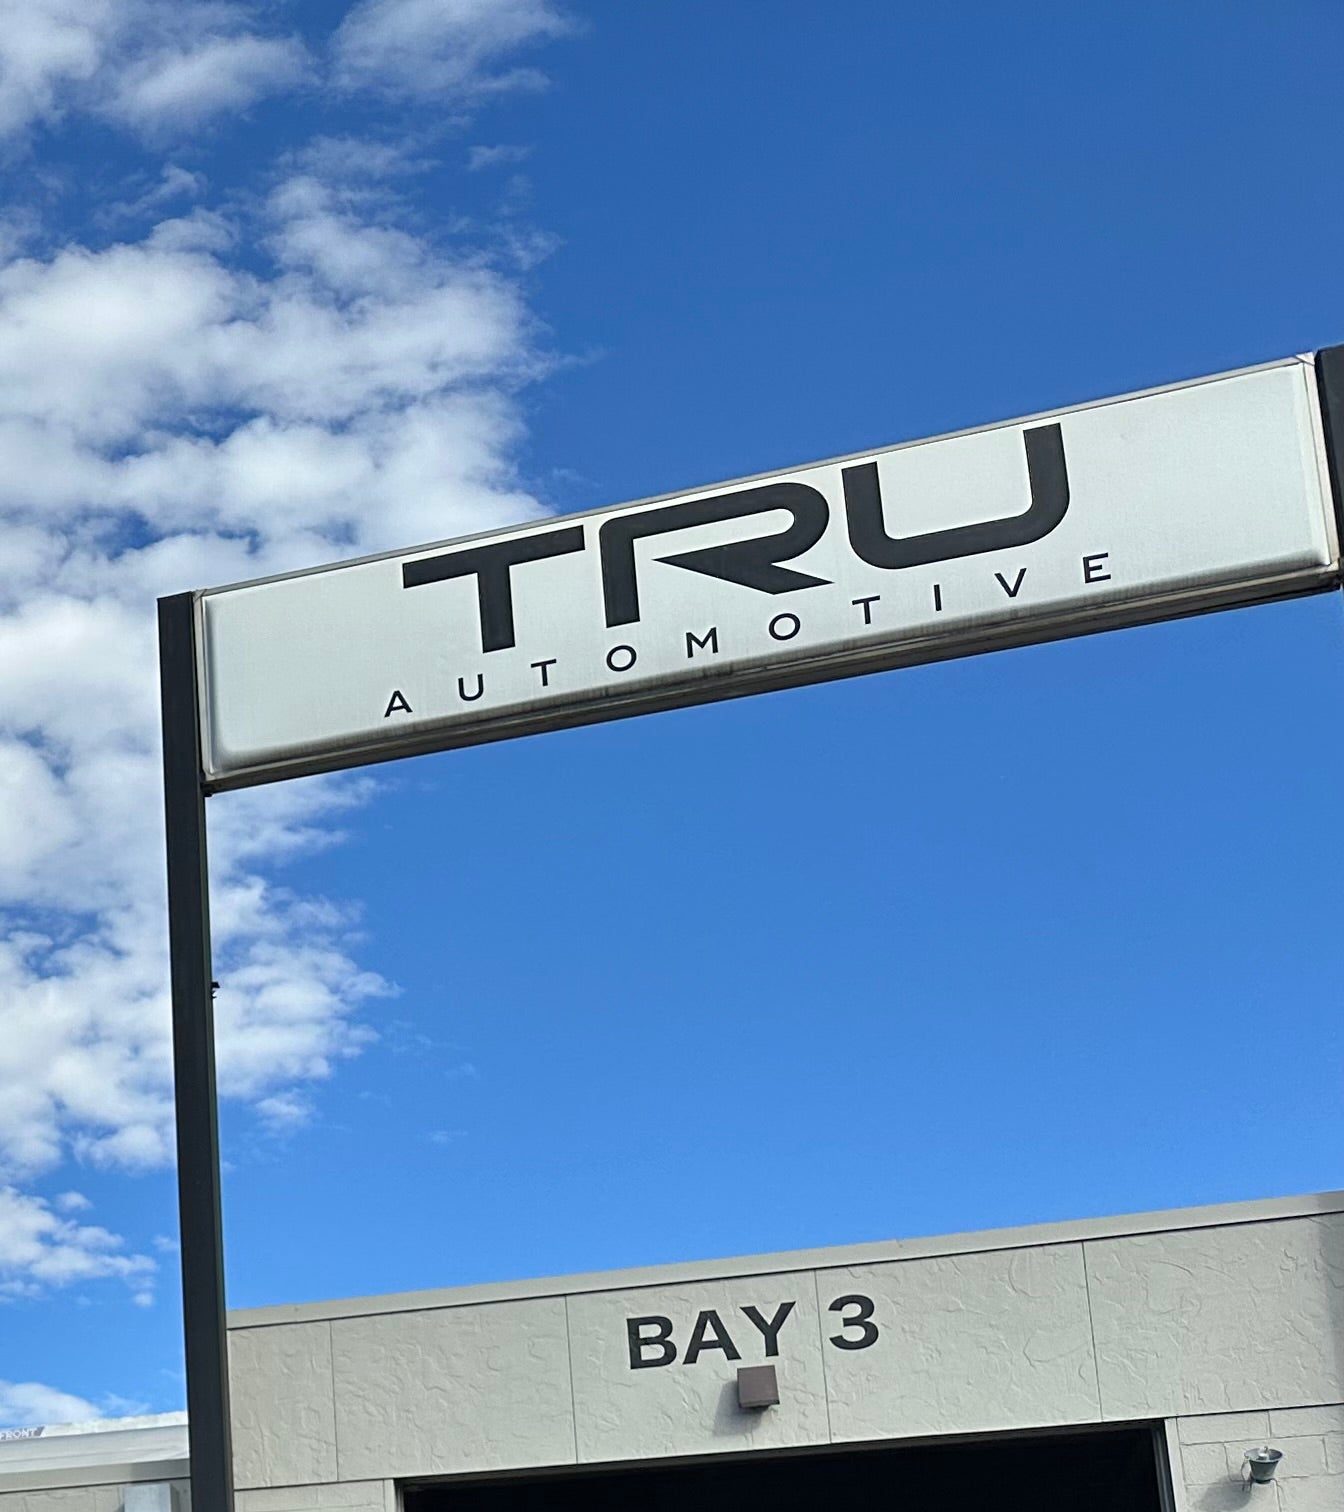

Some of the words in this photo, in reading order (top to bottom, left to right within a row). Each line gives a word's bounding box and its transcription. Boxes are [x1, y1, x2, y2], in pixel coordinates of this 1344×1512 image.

[402, 422, 1071, 654] TRU
[384, 551, 1115, 718] AUTOMOTIVE
[626, 1301, 796, 1370] BAY
[827, 1294, 880, 1351] 3
